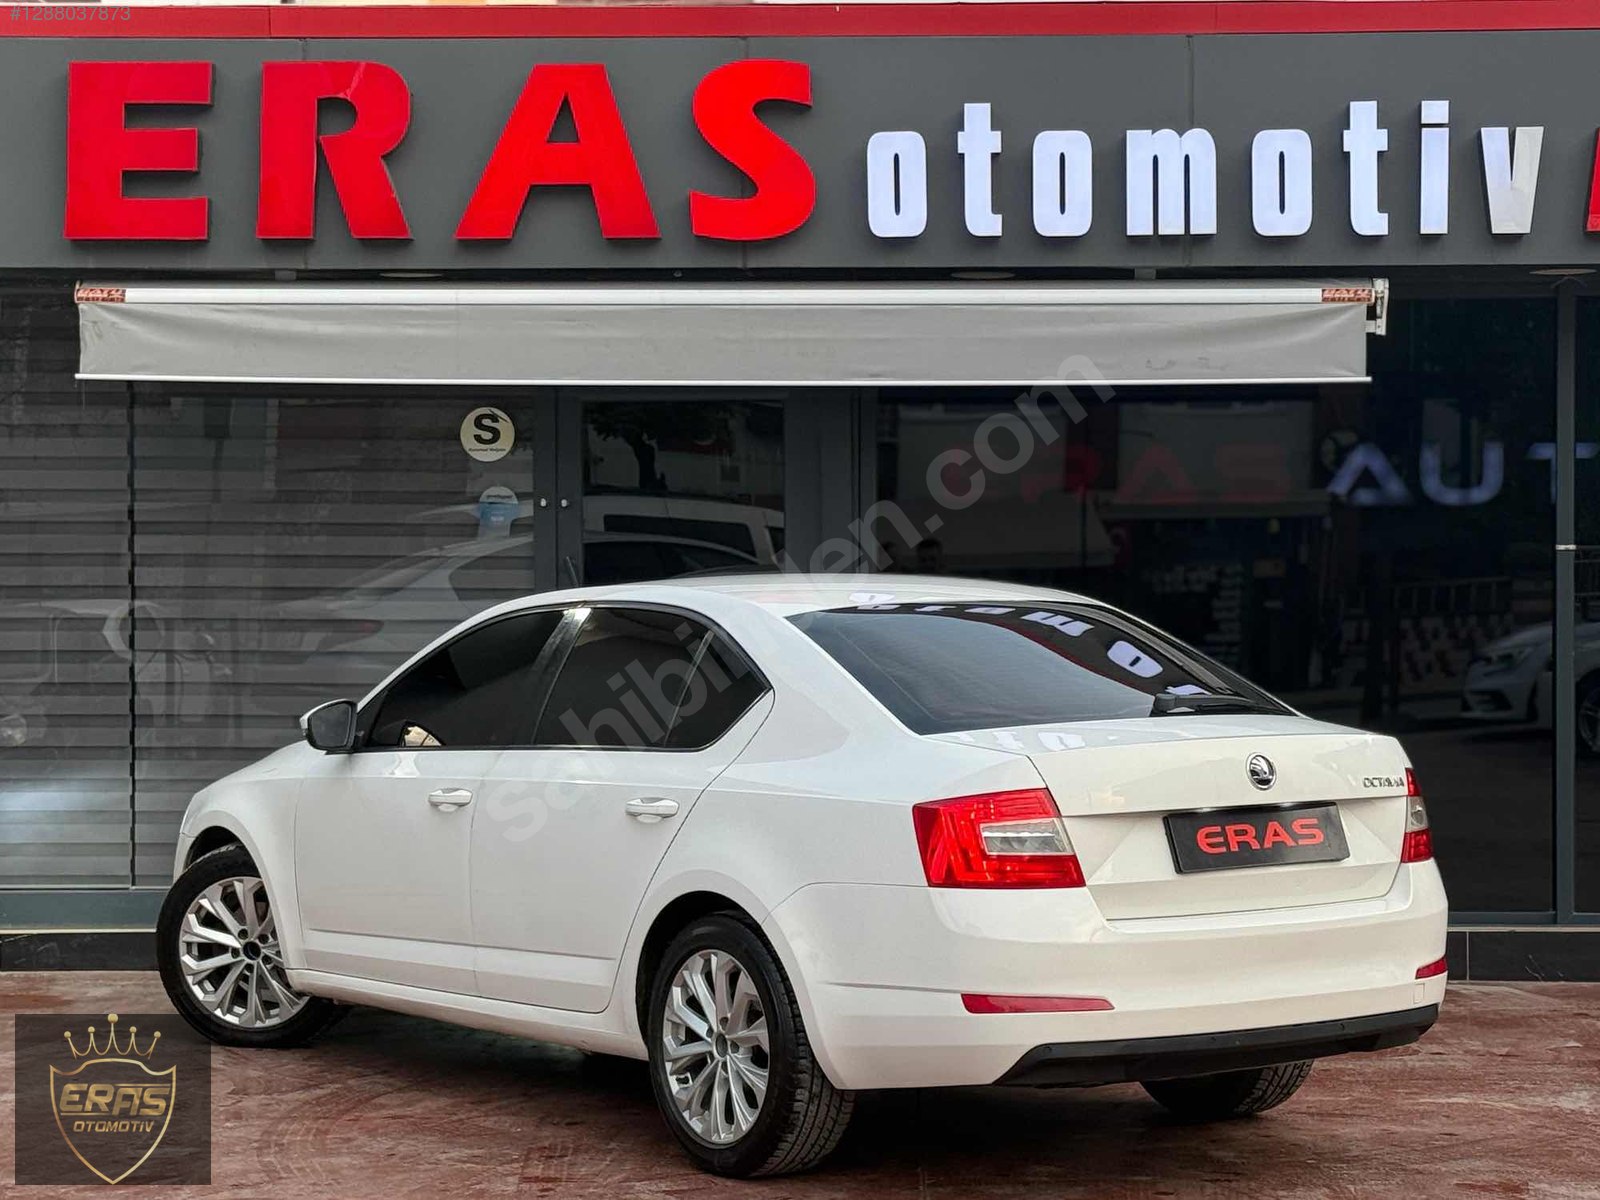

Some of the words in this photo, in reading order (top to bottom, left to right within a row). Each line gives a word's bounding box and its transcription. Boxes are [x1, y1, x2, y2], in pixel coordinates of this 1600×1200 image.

[64, 60, 817, 242] ERAS
[866, 100, 1544, 238] otomotiv
[473, 413, 501, 445] S
[1196, 818, 1325, 854] ERAS
